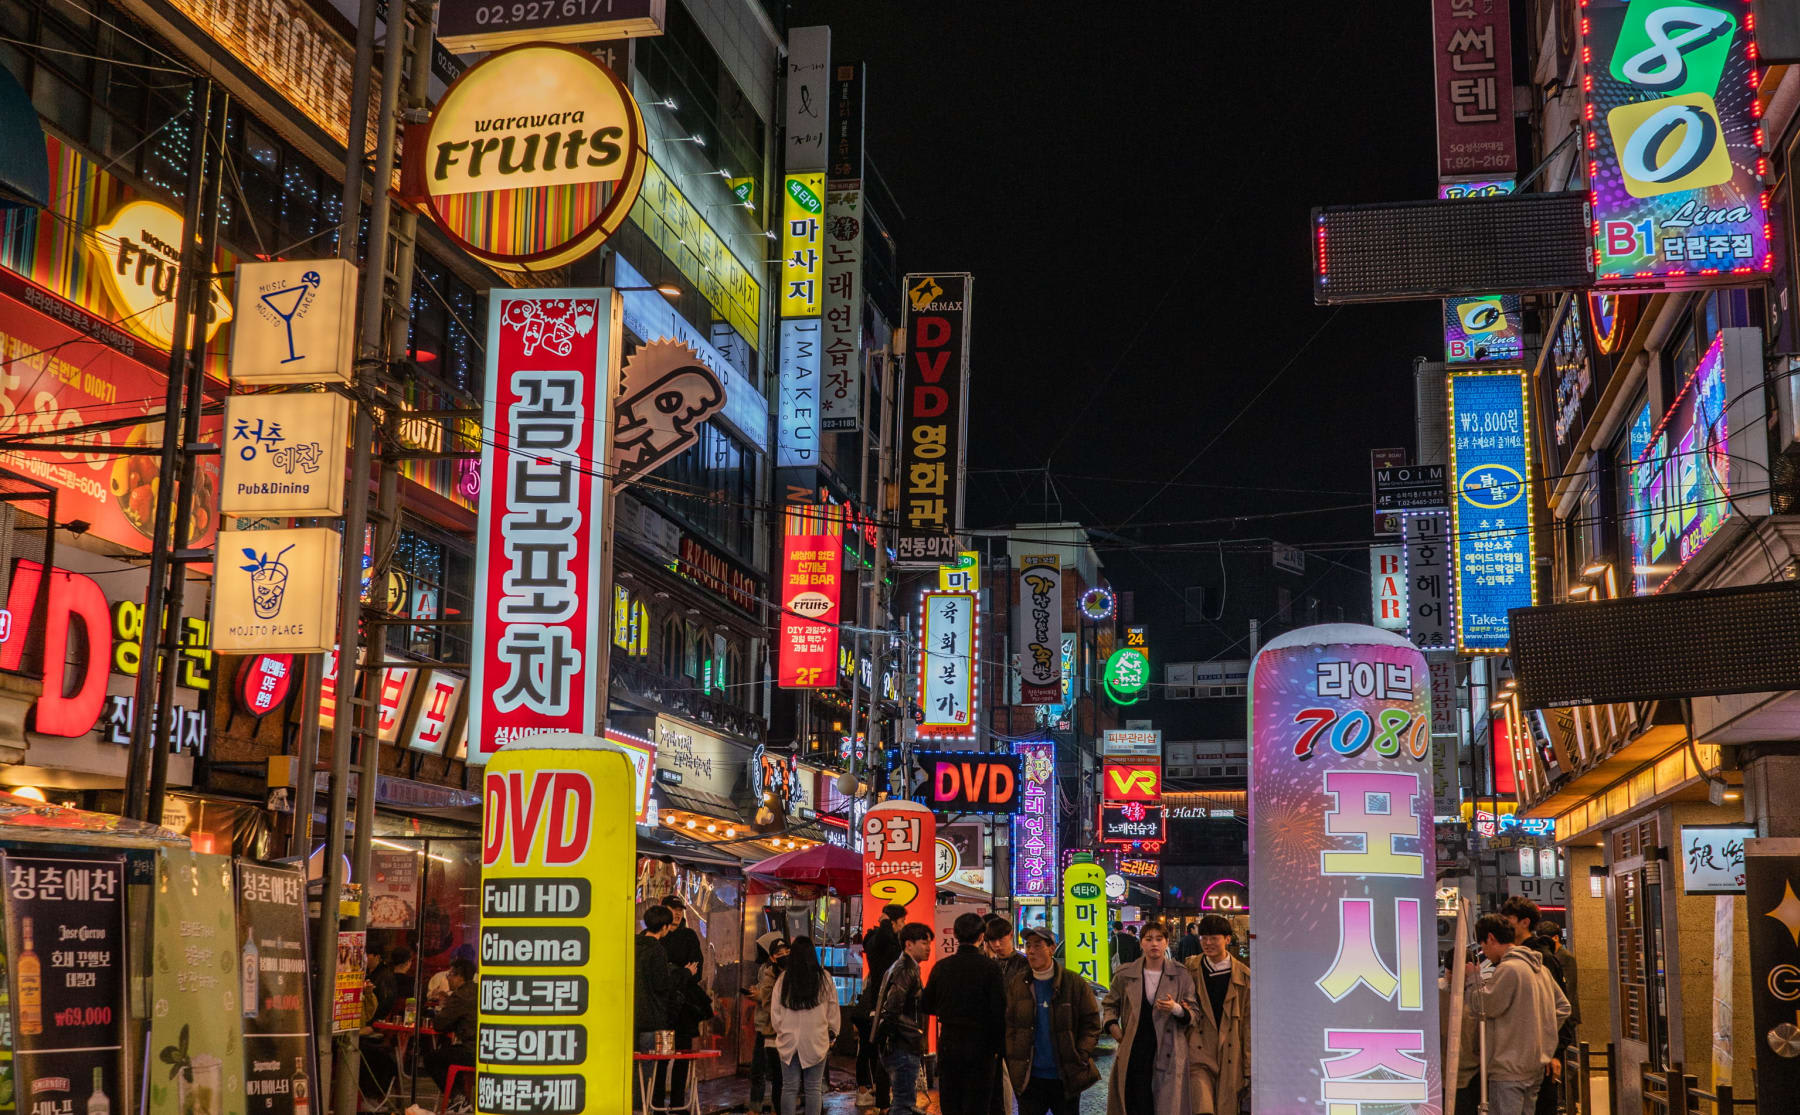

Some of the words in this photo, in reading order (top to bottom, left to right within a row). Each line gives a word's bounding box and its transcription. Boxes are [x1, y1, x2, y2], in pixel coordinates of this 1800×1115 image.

[1448, 26, 1497, 122] 썬텐
[474, 110, 584, 132] warawara
[434, 126, 624, 181] Fruits
[1444, 155, 1510, 169] T.921-2167
[790, 182, 820, 212] 넥타이
[1661, 200, 1752, 228] Lina
[1605, 219, 1656, 257] B1
[1662, 233, 1753, 261] 단란주점
[788, 218, 819, 304] 마사지
[259, 279, 287, 292] MUSIC
[255, 303, 281, 328] MOJITO
[296, 290, 316, 319] PLACE
[827, 244, 857, 399] 노래연습장
[1451, 340, 1475, 357] B1
[1478, 335, 1518, 346] Lina
[913, 317, 951, 417] DVD
[84, 373, 117, 406] 이야기
[794, 324, 818, 460] JMAKEUP
[233, 418, 286, 462] 청춘
[238, 482, 310, 496] Pub&Dining
[908, 425, 949, 528] 영화관
[495, 371, 584, 716] 꼼보포차
[686, 538, 729, 600] BROWN
[733, 568, 757, 613] CITY
[811, 574, 834, 585] BAR
[1380, 555, 1400, 619] BAR
[793, 601, 829, 609] Fruits
[229, 626, 268, 637] MOJITO
[270, 624, 304, 637] PLACE
[787, 626, 804, 634] DIY
[1128, 634, 1144, 645] 24
[936, 601, 959, 717] 육회본가
[795, 667, 822, 685] 2F
[1316, 661, 1413, 701] 라이브
[107, 695, 207, 757] 진의자
[1293, 708, 1429, 760] 7080
[934, 761, 1014, 804] DVD
[1109, 770, 1157, 795] VR
[484, 769, 594, 868] DVD
[1025, 781, 1046, 876] 노래연습장
[1108, 823, 1158, 836] 노래연습장
[866, 816, 921, 860] 육회
[11, 867, 118, 902] 청춘예찬
[242, 870, 299, 906] 청춘예찬
[484, 885, 526, 913] Full
[534, 885, 580, 913] HD
[1028, 881, 1041, 891] B1
[482, 933, 581, 962] Cinema
[1075, 904, 1099, 981] 마사지
[51, 952, 75, 968] 호세
[481, 980, 579, 1011] 대형스크린
[479, 1029, 577, 1061] 진동의자
[478, 1077, 577, 1111] 영화+팝콘+커피
